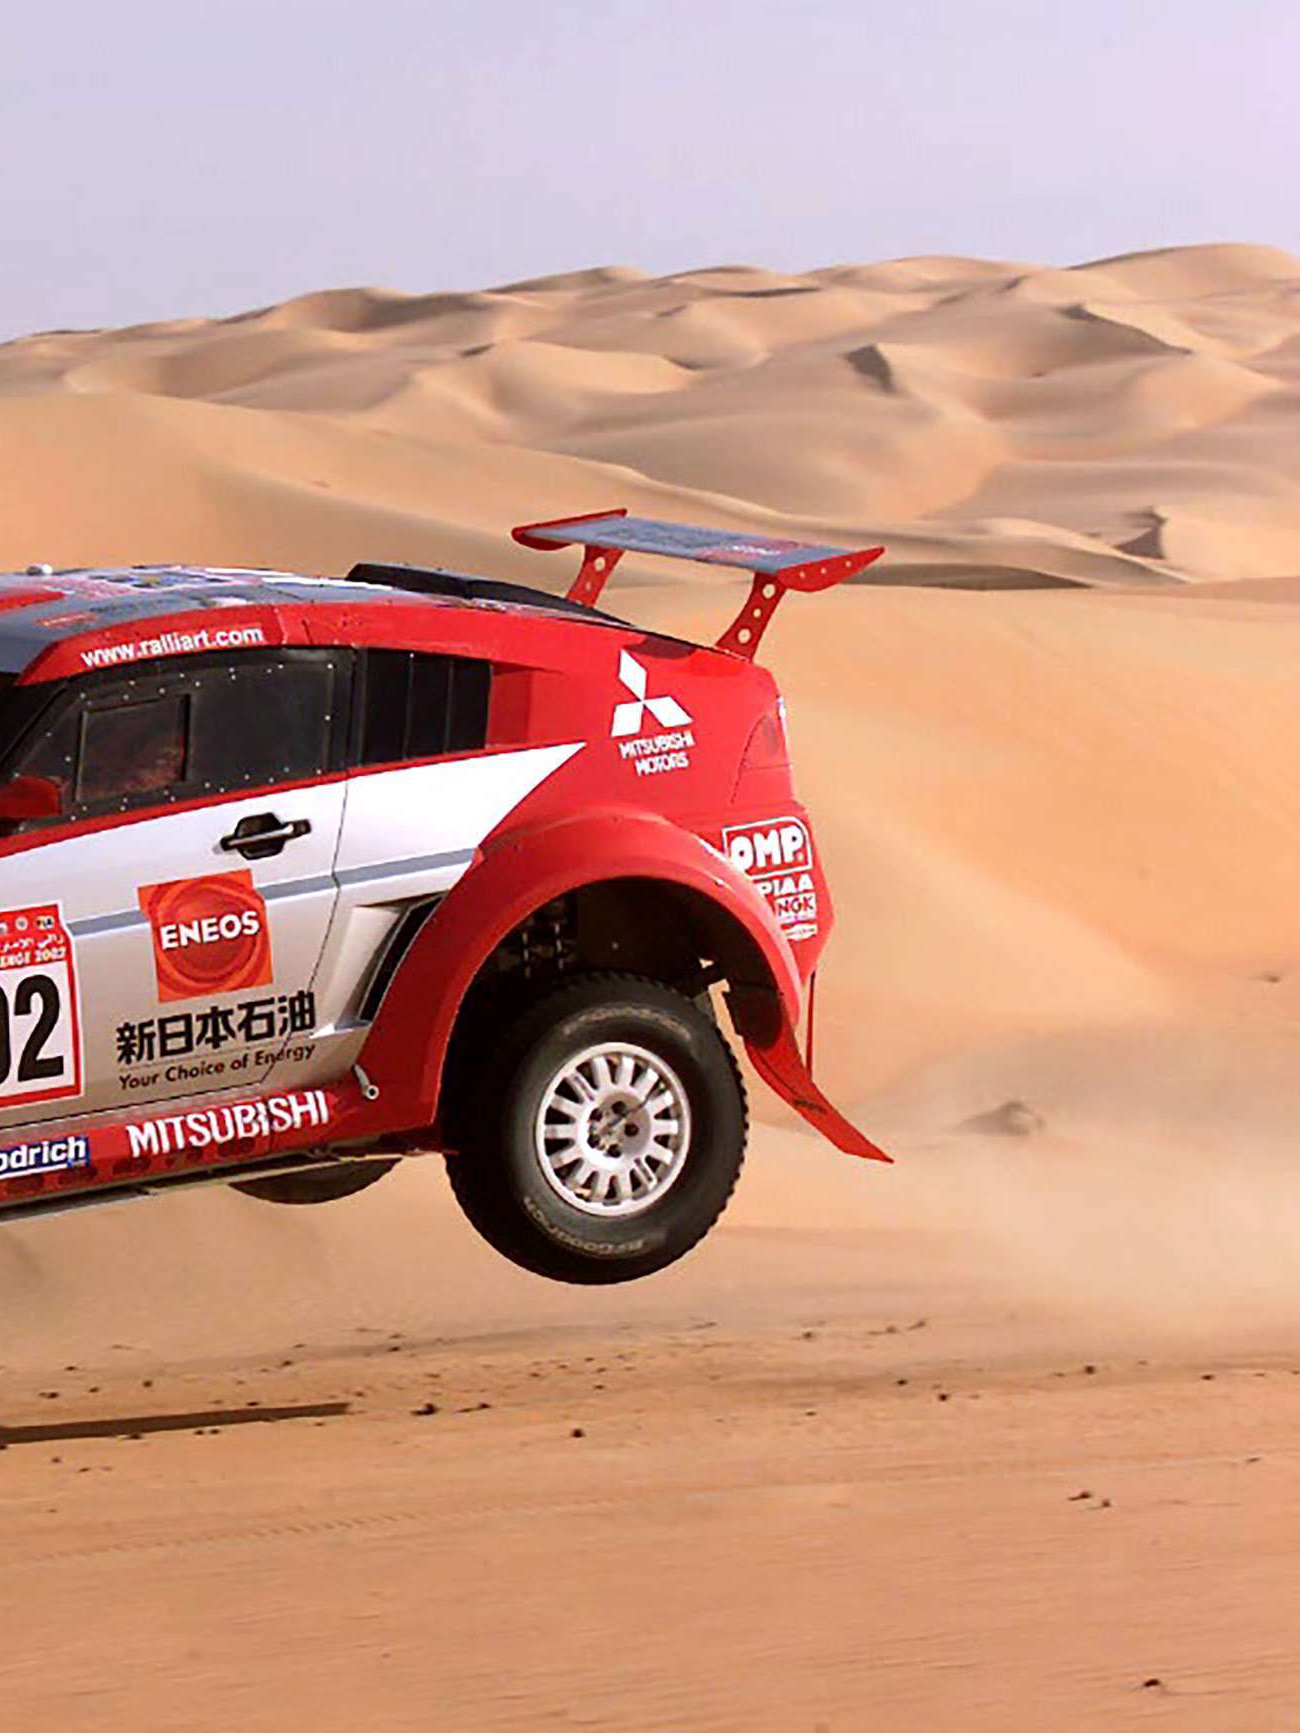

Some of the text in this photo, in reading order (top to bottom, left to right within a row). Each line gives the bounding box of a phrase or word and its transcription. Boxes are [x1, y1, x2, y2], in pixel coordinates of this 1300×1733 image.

[80, 627, 264, 667] www.ralliart.com
[619, 730, 696, 760] MITSUBISHI
[635, 752, 689, 776] MOTORS
[731, 825, 804, 871] OMP
[755, 873, 814, 896] PIAA
[778, 895, 814, 916] NGK
[160, 911, 259, 950] ENEOS
[116, 990, 316, 1065] 新日本石油
[119, 1044, 316, 1090] Your Choice of Energy
[125, 1090, 329, 1158] MITSUBISHI
